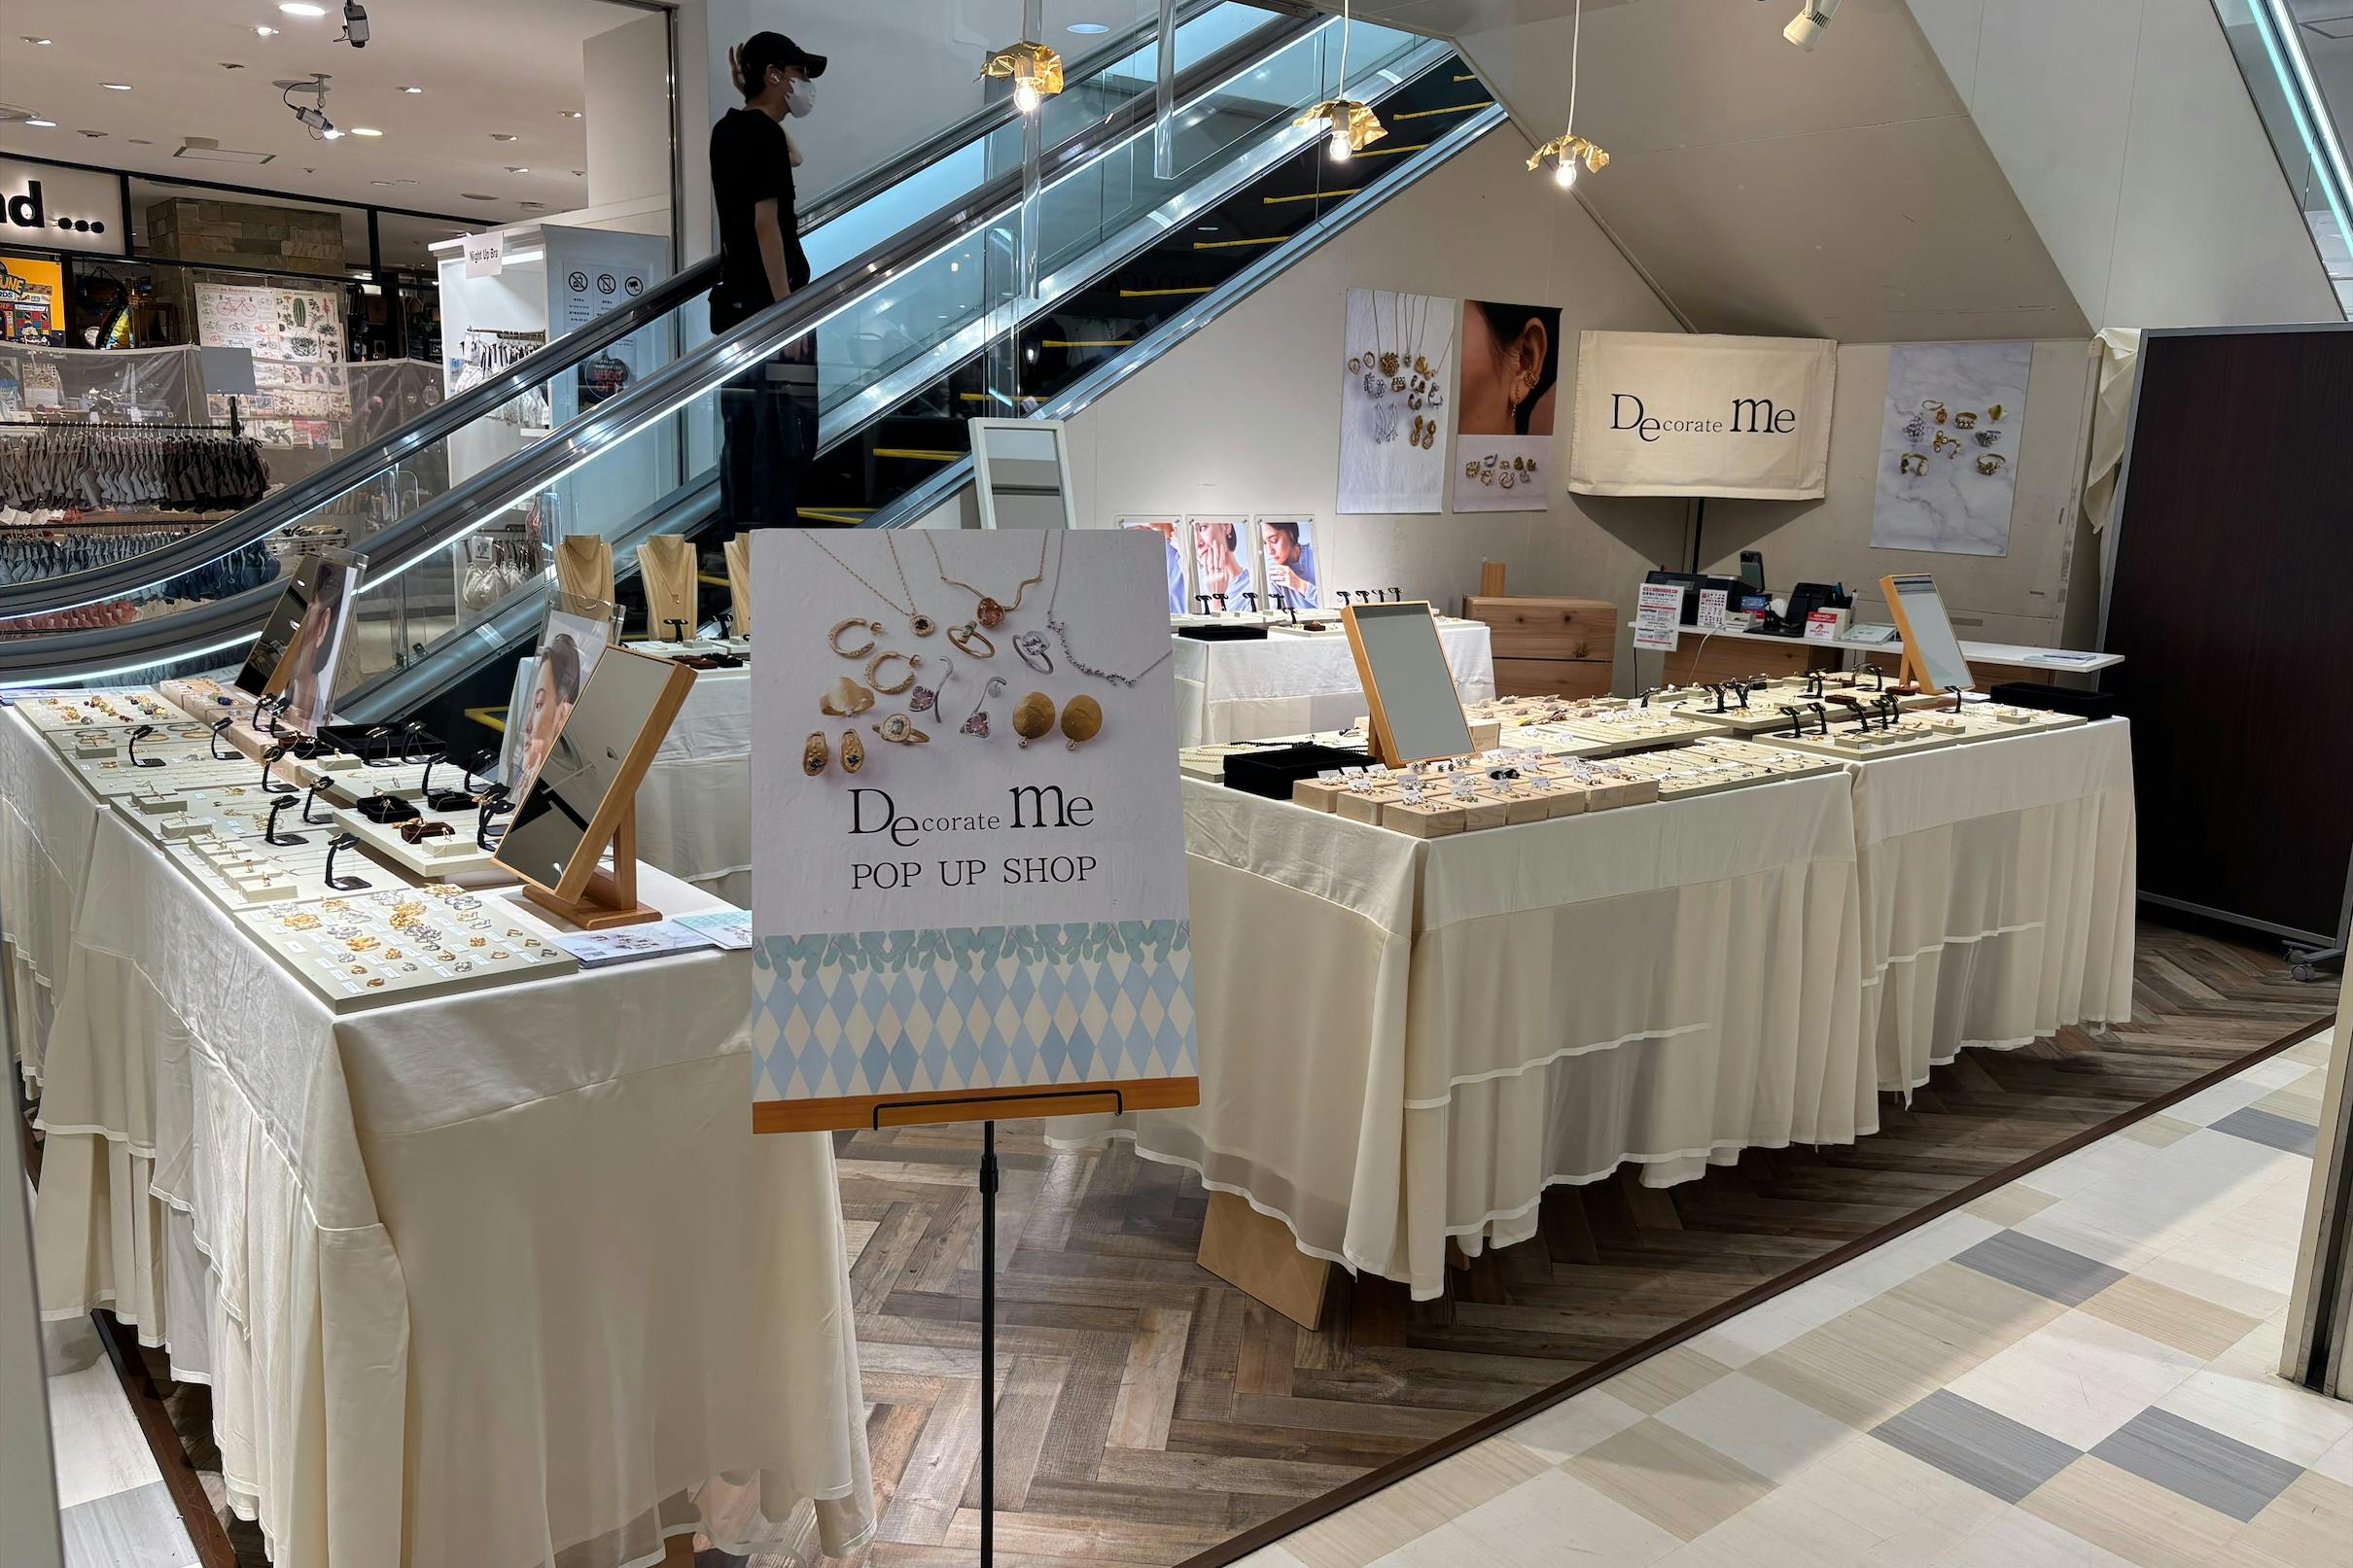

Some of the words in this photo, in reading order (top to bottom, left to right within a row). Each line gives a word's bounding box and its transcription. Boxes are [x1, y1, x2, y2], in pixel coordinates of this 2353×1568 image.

[1610, 393, 1723, 441] Decorate
[847, 788, 1001, 847] Decorate
[851, 861, 922, 889] POP
[937, 859, 987, 887] UP
[1002, 855, 1097, 885] SHOP
